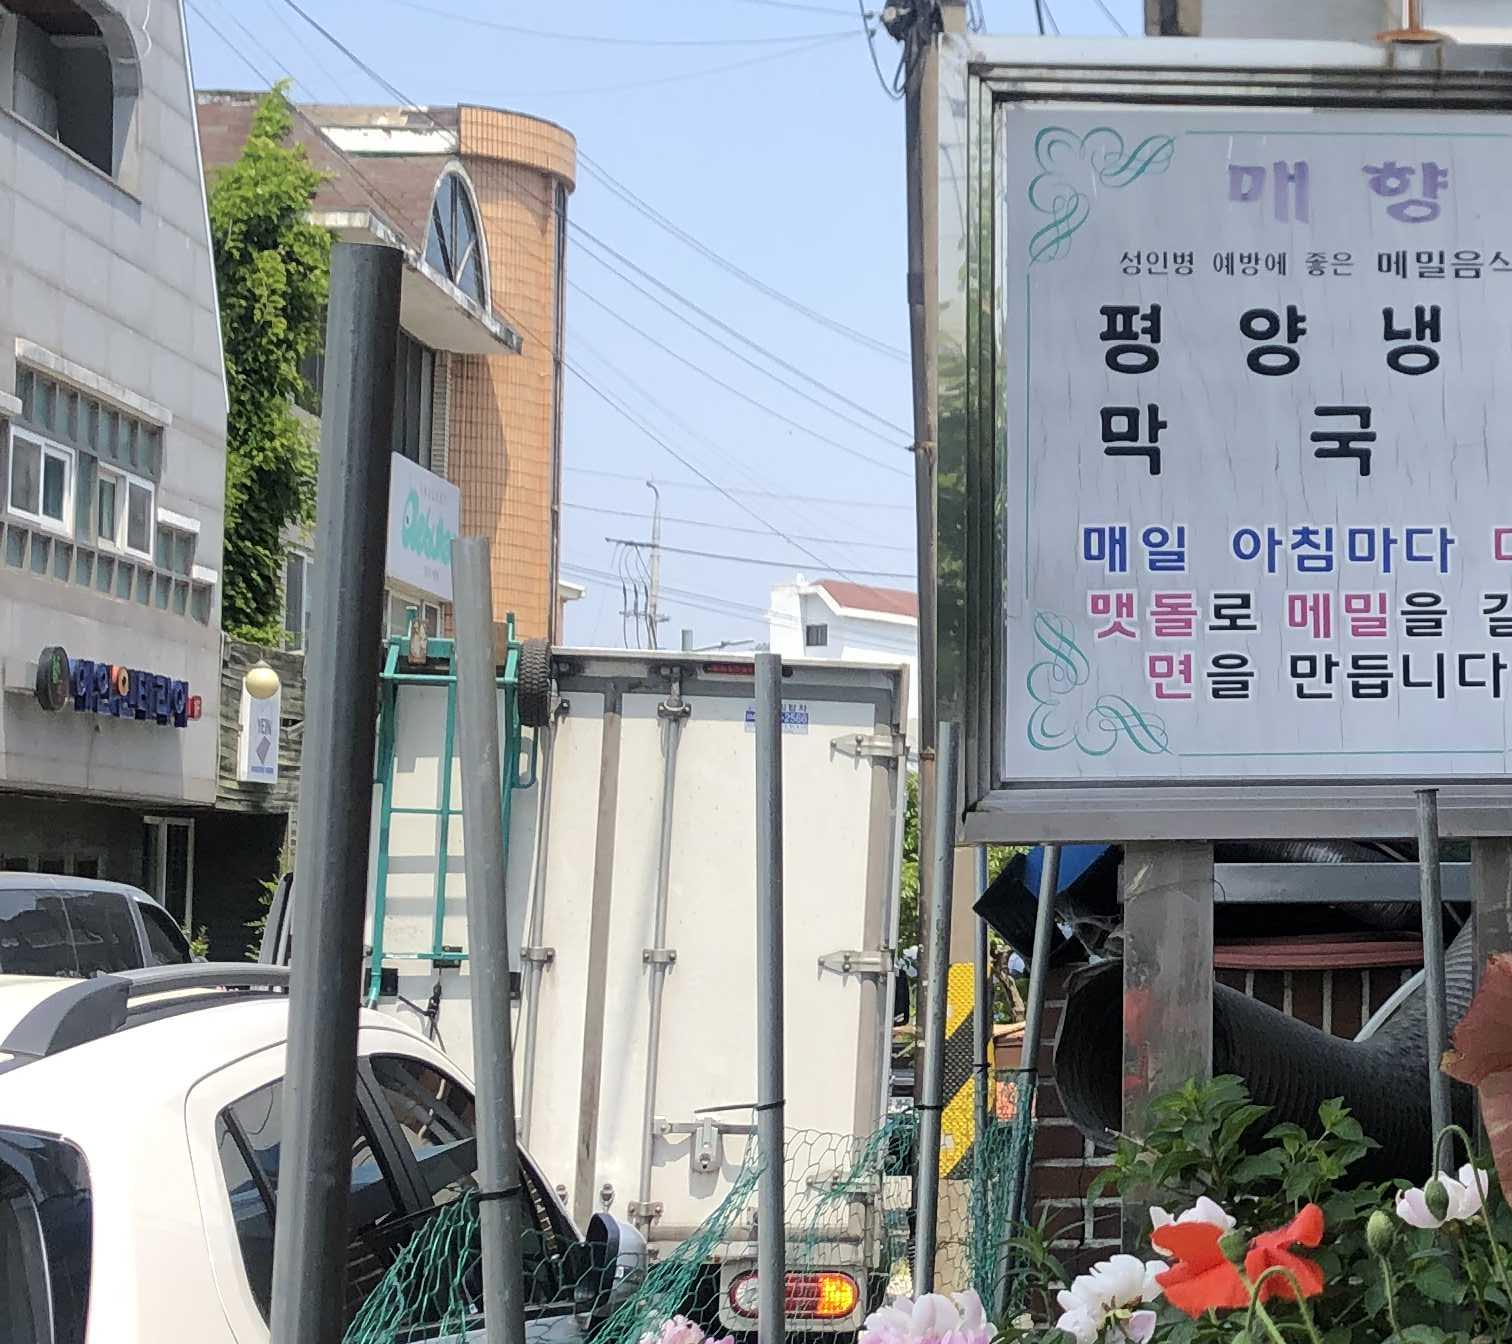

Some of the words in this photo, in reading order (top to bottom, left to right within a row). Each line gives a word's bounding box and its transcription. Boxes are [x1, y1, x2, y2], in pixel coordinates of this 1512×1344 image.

[1120, 251, 1194, 276] 성인병
[1213, 251, 1287, 277] 예방에
[1305, 252, 1354, 277] 좋은
[1084, 527, 1186, 573] 매일
[1232, 526, 1455, 573] 아침마다
[1091, 593, 1257, 639] 맷돌로
[1288, 592, 1447, 639] 메밀을
[1149, 653, 1255, 700] 면을
